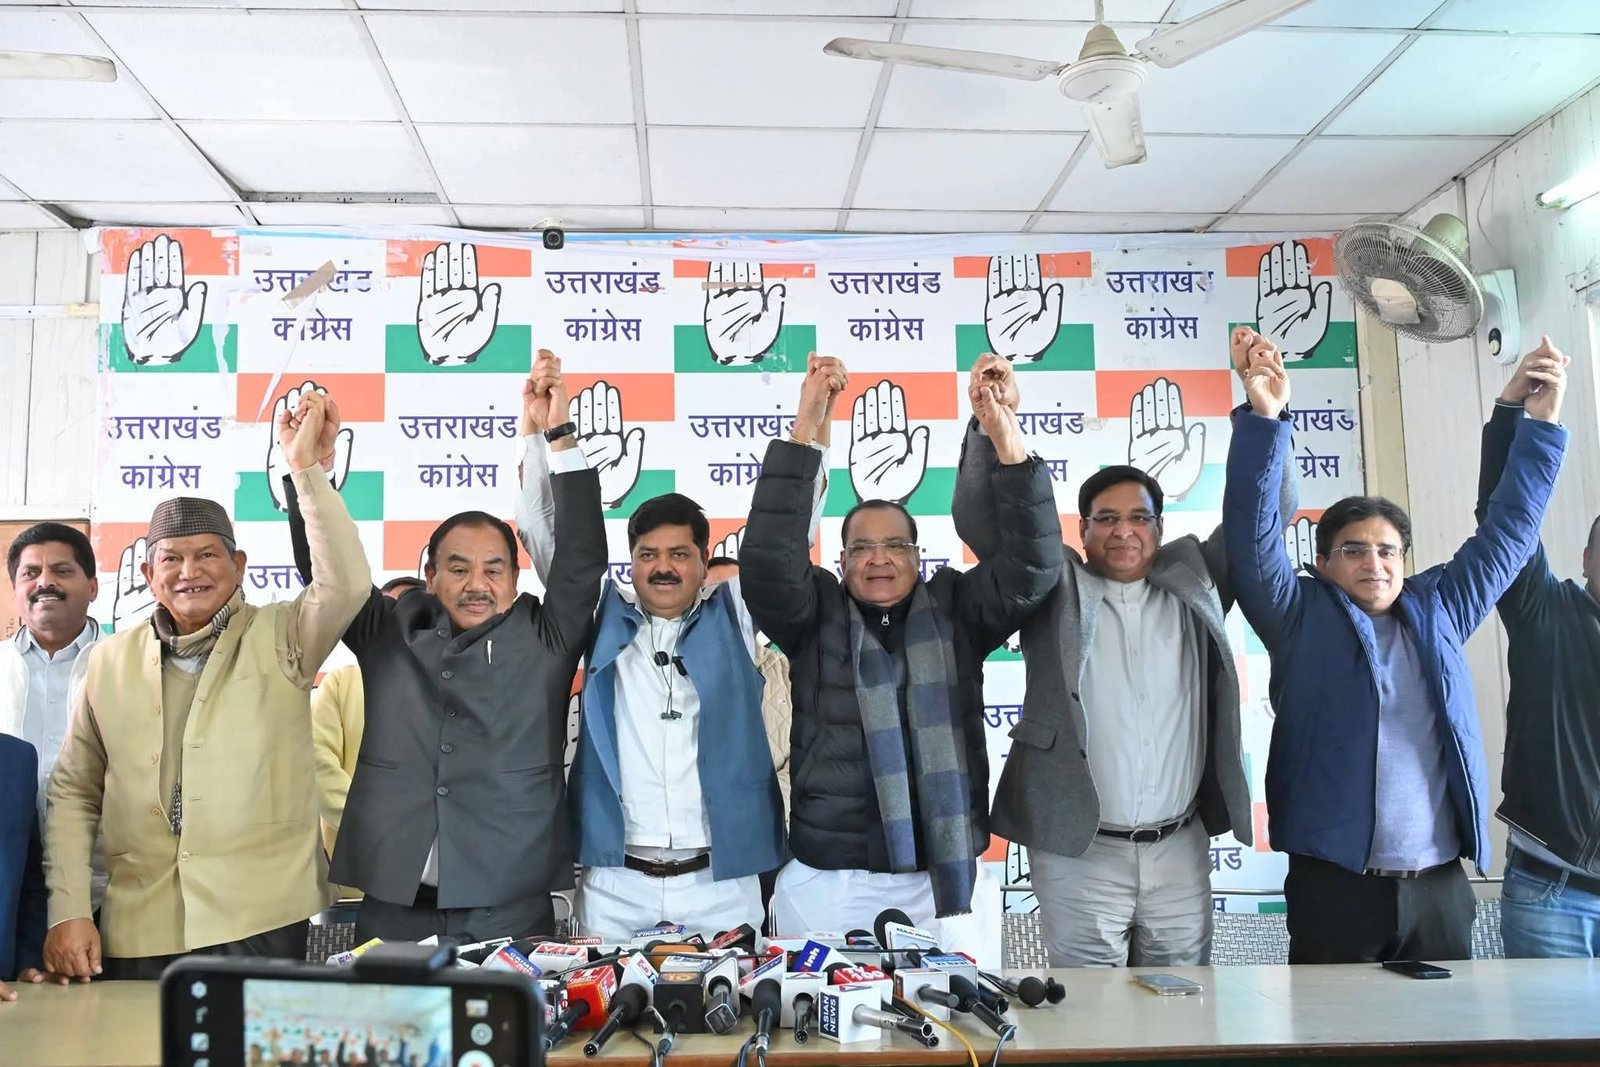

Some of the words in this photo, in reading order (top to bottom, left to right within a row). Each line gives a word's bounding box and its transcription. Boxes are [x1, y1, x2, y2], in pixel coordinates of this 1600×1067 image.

[253, 259, 373, 293] उत्तखंड
[545, 261, 661, 294] उत्तराखंड
[829, 261, 941, 294] उत्तराखंड
[271, 307, 353, 341] काग्रेस
[564, 308, 641, 341] कांग्रेस
[848, 308, 925, 341] कांग्रेस
[1124, 306, 1199, 340] कांग्रेस
[107, 405, 222, 440] उत्तराखंड
[399, 405, 517, 440] उत्तराखंड
[1015, 402, 1085, 435] राखंड
[1289, 398, 1355, 431] राखंड
[120, 454, 202, 489] कांग्रेस
[418, 453, 499, 488] कांग्रेस
[707, 452, 762, 486] कांग्रे
[1295, 446, 1340, 478] ग्रेस
[509, 951, 535, 973] CRIME
[822, 993, 831, 1032] ASIAN
[829, 998, 838, 1033] NEWS
